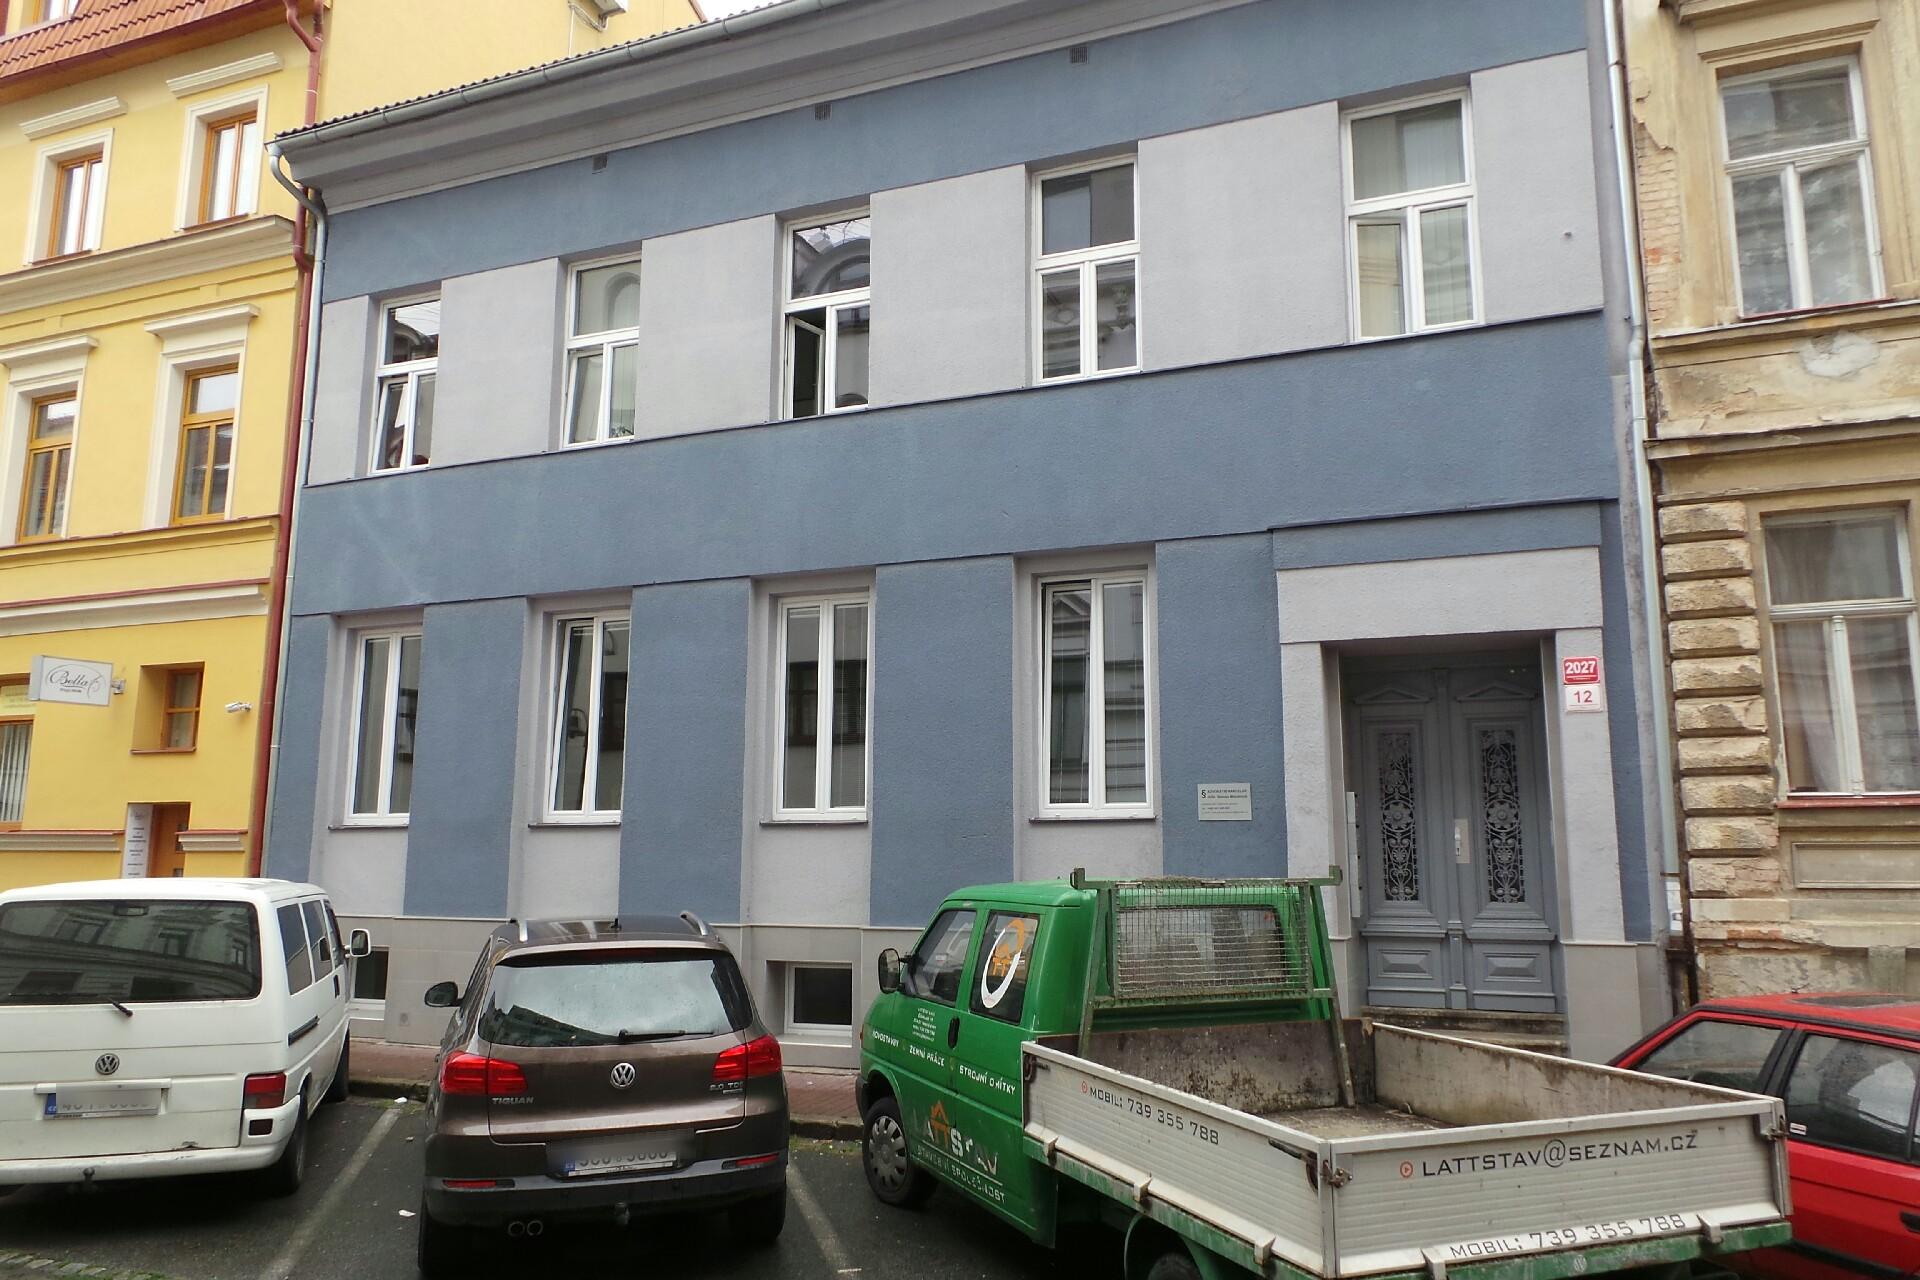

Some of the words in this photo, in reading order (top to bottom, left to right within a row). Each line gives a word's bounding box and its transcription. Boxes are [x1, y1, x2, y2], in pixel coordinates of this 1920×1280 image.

[1565, 661, 1596, 674] 2027
[50, 670, 89, 687] Bella
[1574, 690, 1593, 703] 12
[959, 1064, 988, 1085] STROJNÍ
[492, 1096, 535, 1105] TIGUAN
[1090, 1087, 1123, 1109] MOBIL:
[1128, 1098, 1152, 1119] 739
[1157, 1109, 1184, 1131] 355
[1190, 1121, 1219, 1146] 788
[1422, 1133, 1698, 1177] LATTSTAV@SEZNAM.CZ
[1450, 1236, 1523, 1258] MOBIL:
[1529, 1227, 1578, 1249] 739
[1584, 1220, 1634, 1241] 355
[1640, 1213, 1687, 1233] 788
